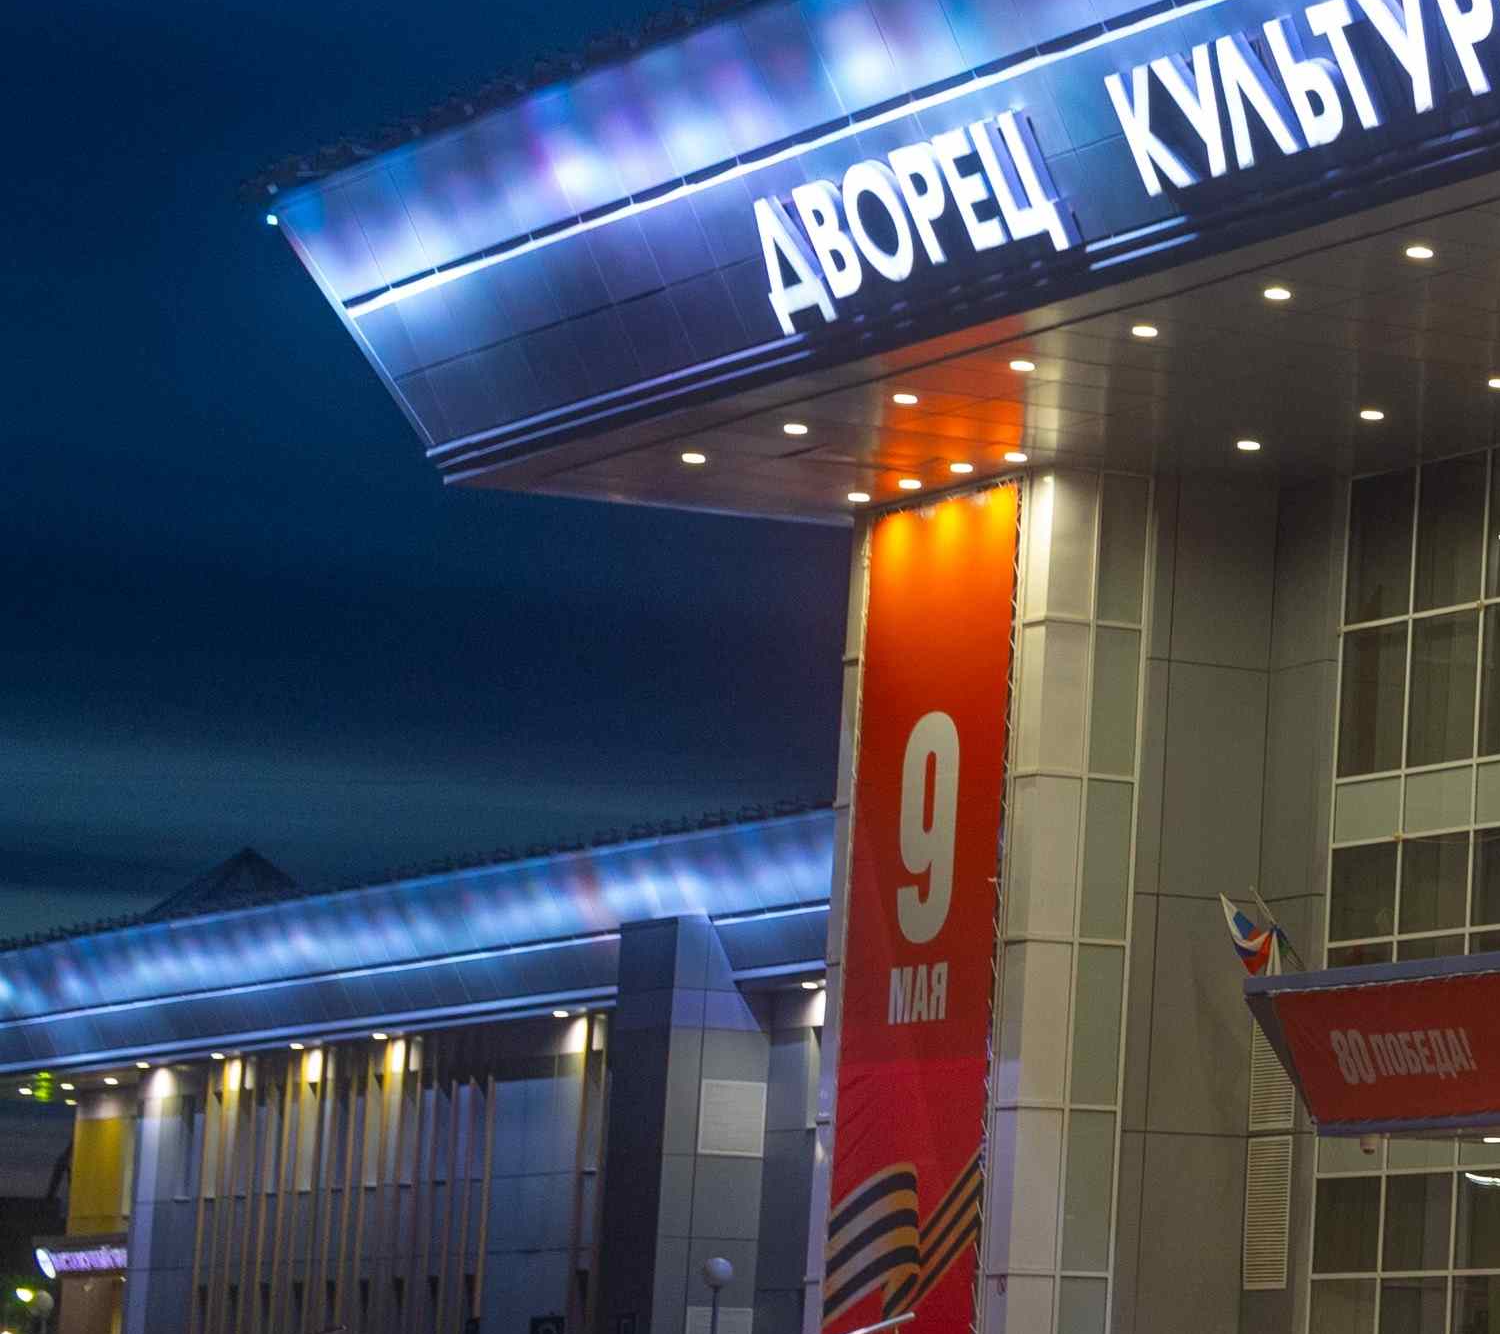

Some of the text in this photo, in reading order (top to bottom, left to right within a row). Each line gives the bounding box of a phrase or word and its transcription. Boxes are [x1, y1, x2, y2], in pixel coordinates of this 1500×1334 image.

[752, 110, 1074, 335] ДВОРЕЦ
[896, 710, 960, 944] 9
[887, 962, 949, 1026] МАЯ
[1328, 1027, 1479, 1085] 80 ПОБЕДА!
